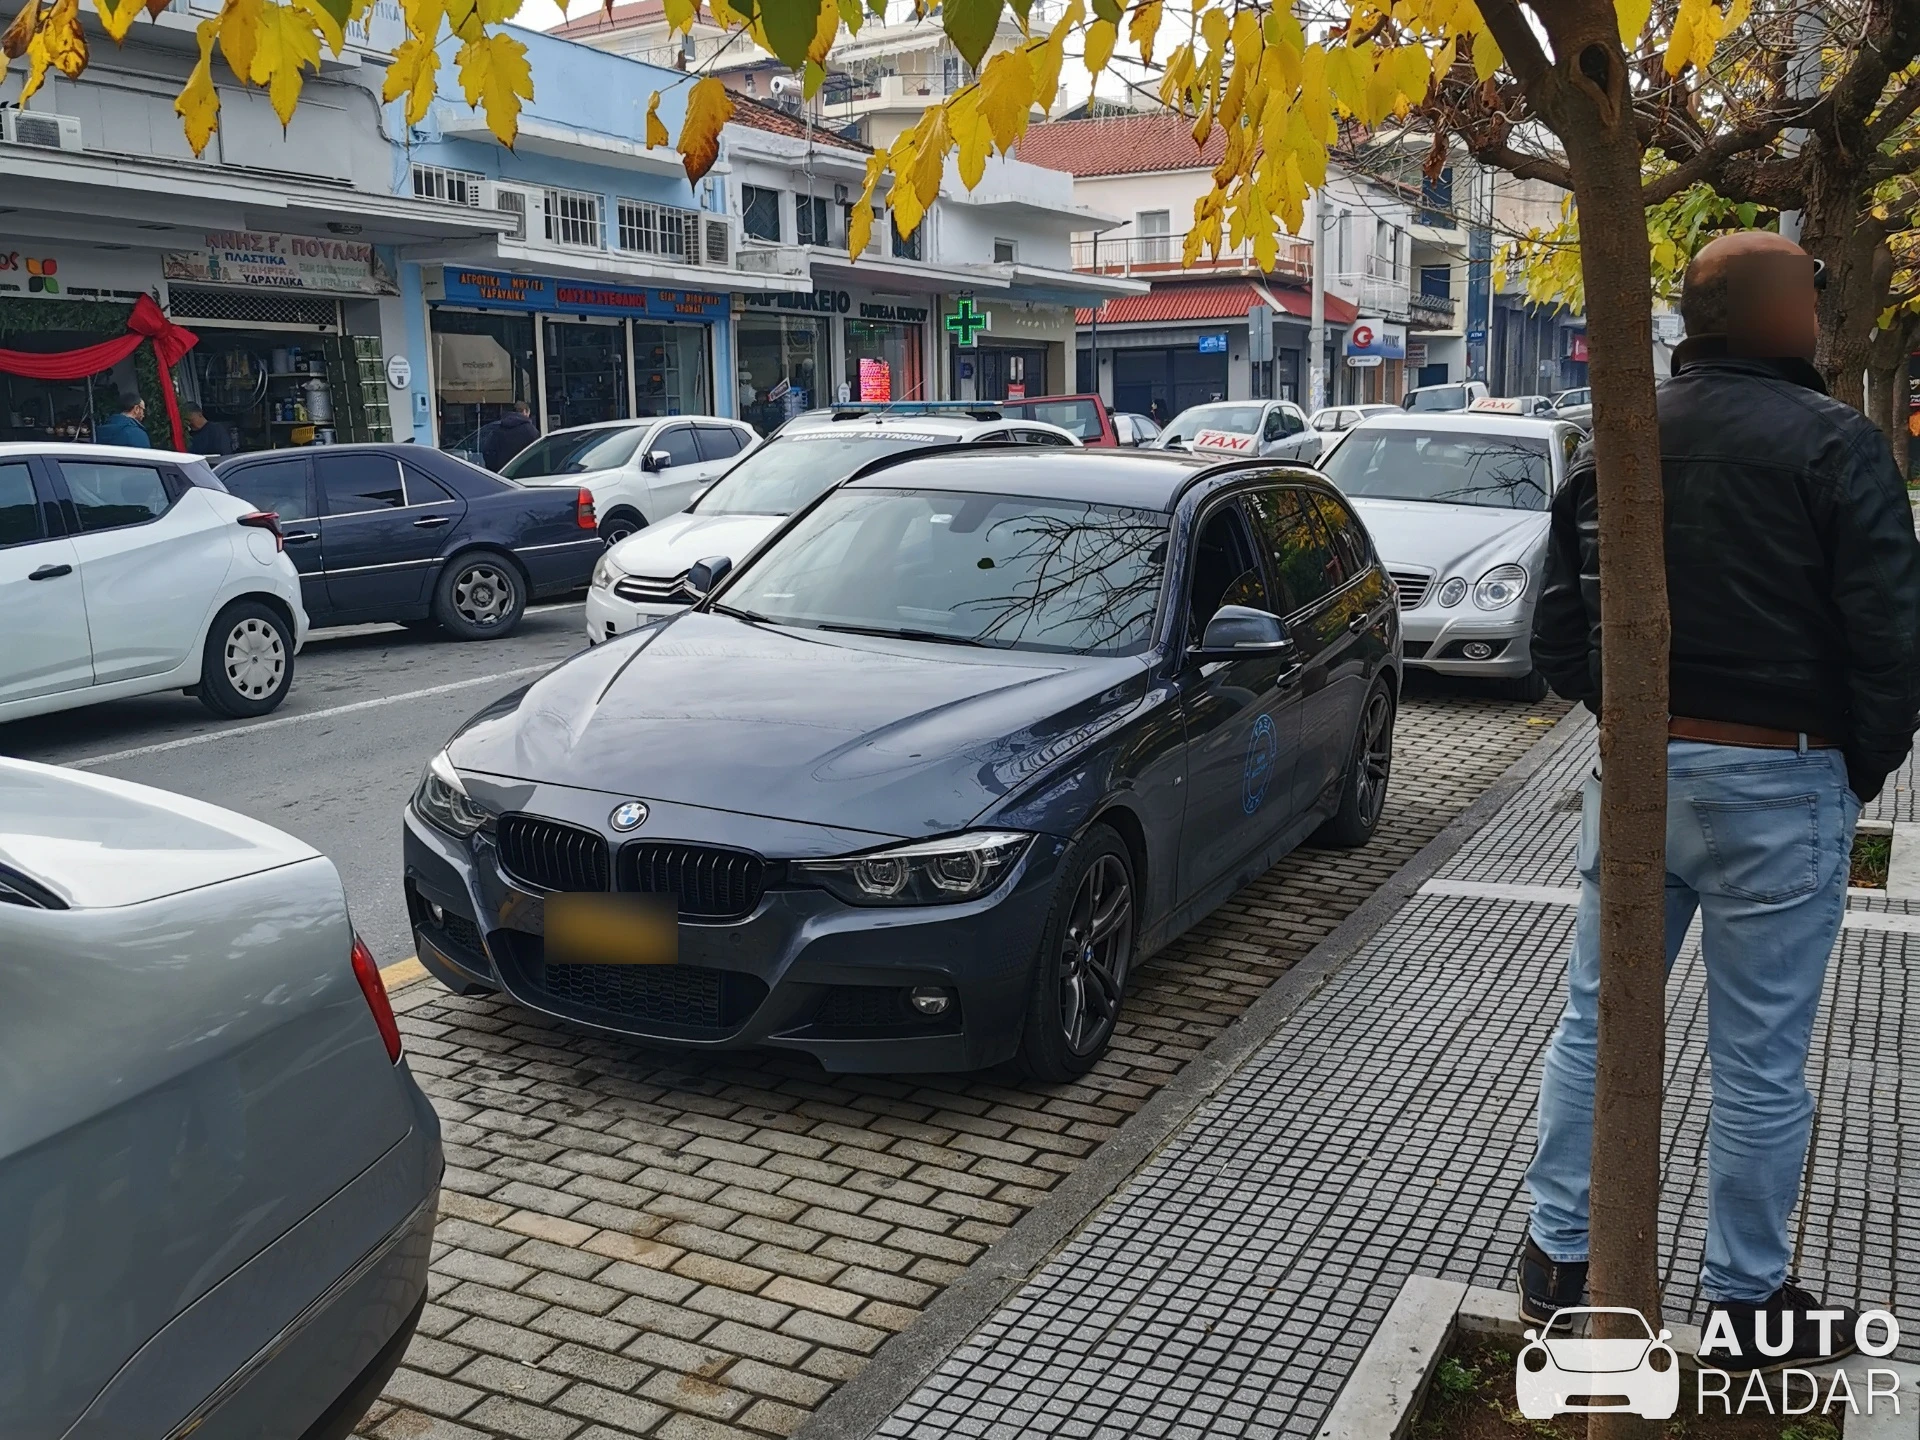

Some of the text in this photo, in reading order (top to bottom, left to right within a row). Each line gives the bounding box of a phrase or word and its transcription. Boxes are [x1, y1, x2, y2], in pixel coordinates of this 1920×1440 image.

[225, 252, 286, 266] ΠΛΑΣΤΙΚΑ
[243, 274, 304, 287] ΥΔΡΑΥΛΙΚΑ
[460, 273, 501, 287] ΑΓΡΟΤΙΚΑ
[480, 287, 526, 301] ΥΔΡΑΥΛΙΚΑ
[1470, 331, 1483, 339] ATM
[1476, 400, 1516, 410] TAXI
[859, 432, 936, 443] ΑΣΤΥΝΟΜΙΑ
[1199, 434, 1251, 450] TAXI
